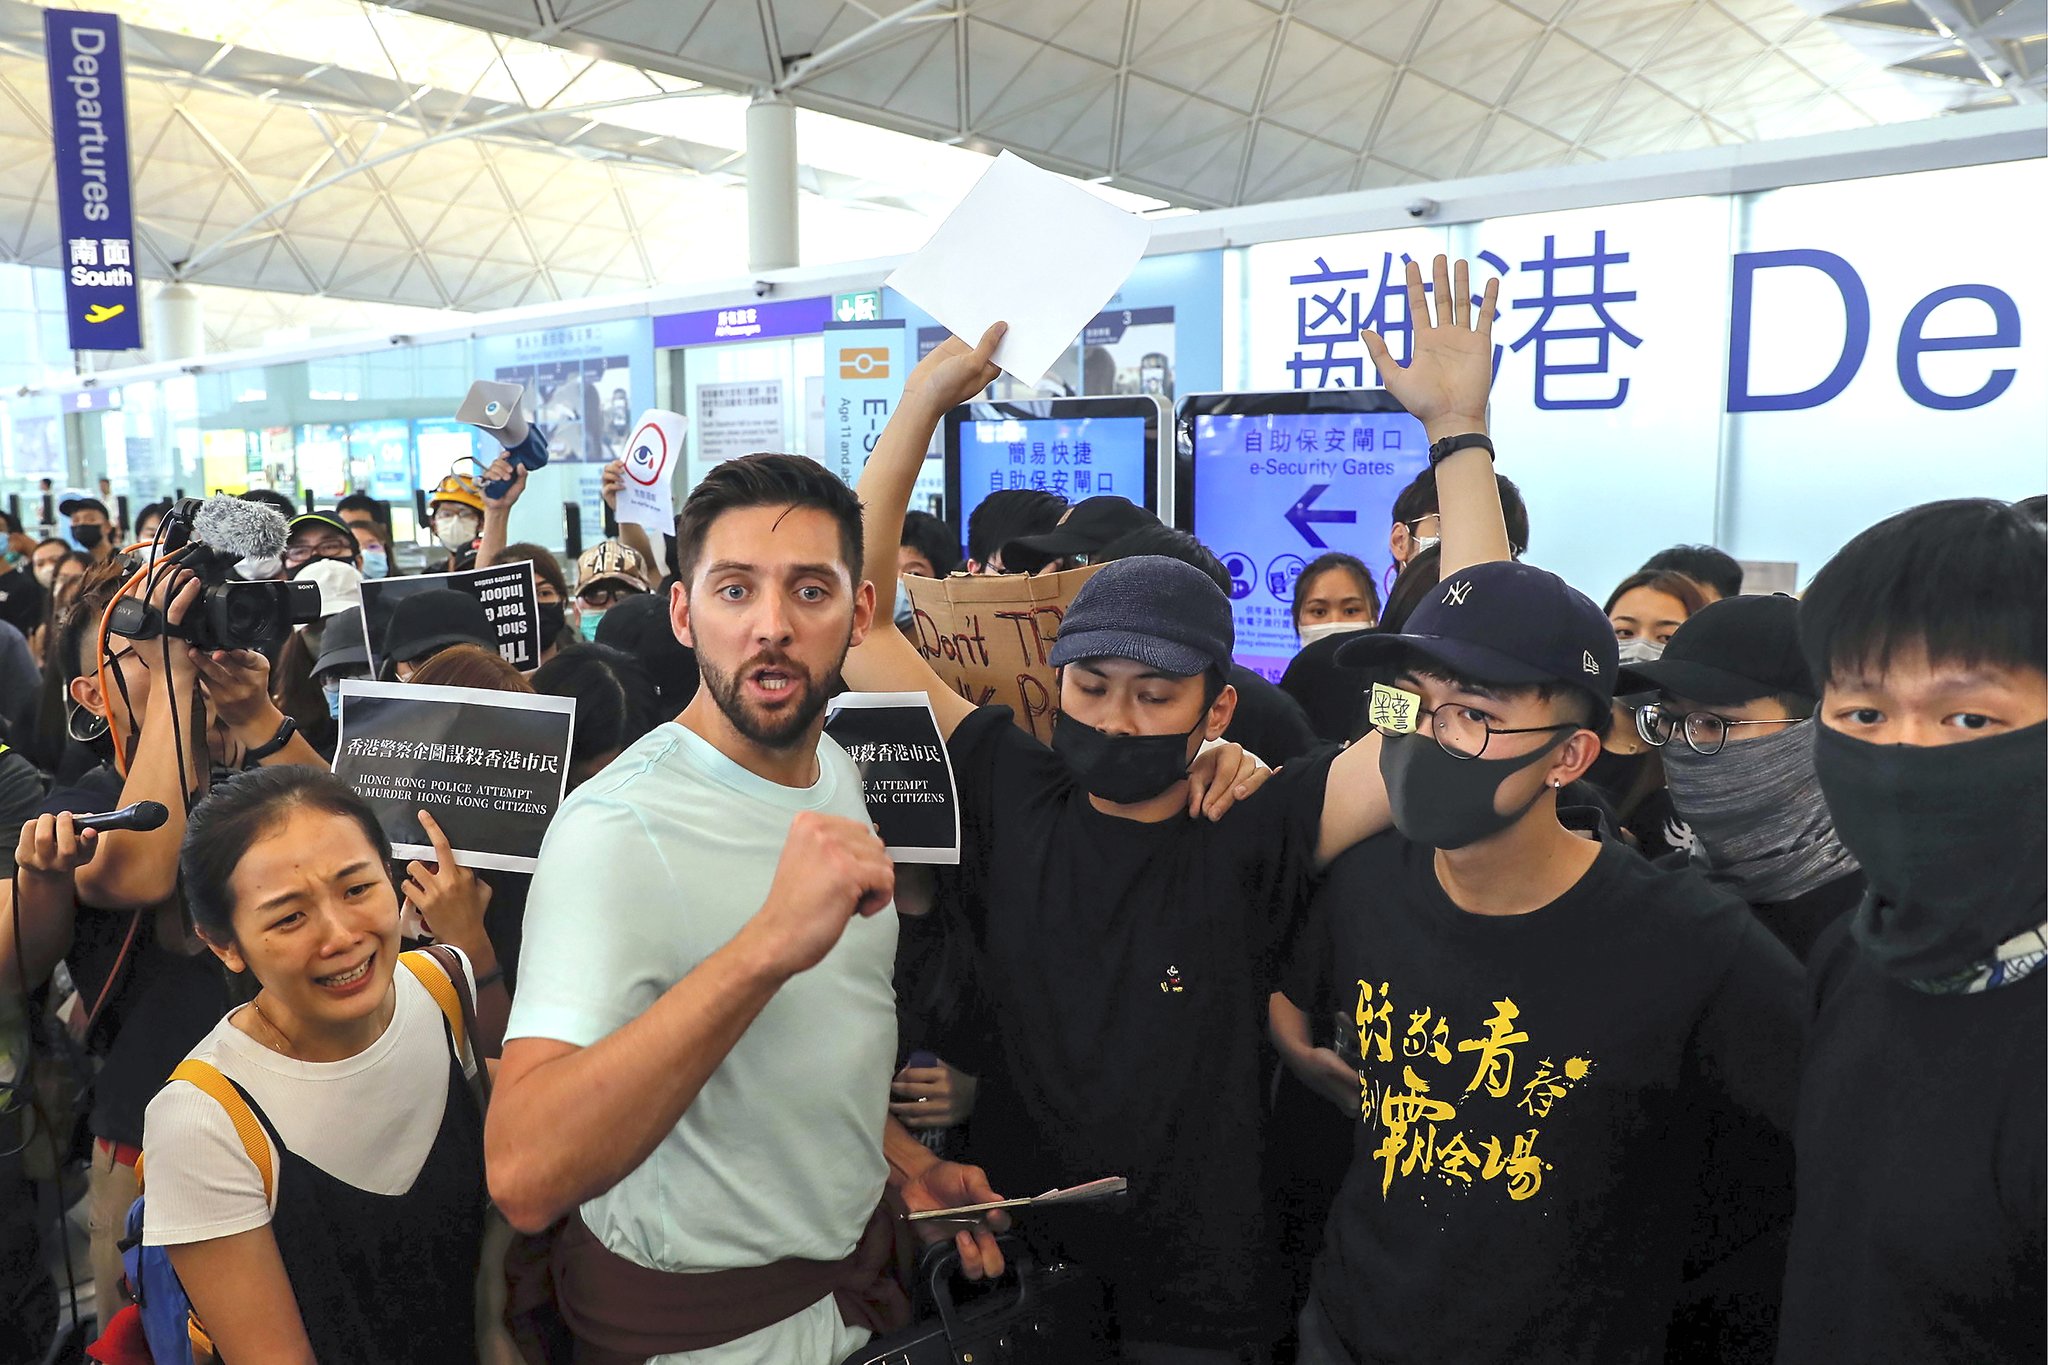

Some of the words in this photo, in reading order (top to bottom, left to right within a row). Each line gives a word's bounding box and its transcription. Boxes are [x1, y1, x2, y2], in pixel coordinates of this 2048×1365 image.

[66, 27, 111, 221] Departures
[69, 237, 131, 266] 南面
[71, 265, 133, 286] South
[1122, 310, 1132, 325] 3
[1727, 248, 2022, 413] De
[839, 398, 851, 422] Age
[841, 427, 851, 438] 11
[863, 399, 887, 467] E-S
[1245, 428, 1402, 453] 自助保安閘口
[841, 441, 851, 465] and
[1008, 441, 1092, 465] 簡易快捷
[1250, 458, 1337, 478] e-Security
[1343, 459, 1394, 475] Gates
[990, 469, 1112, 493] 自助保安閘口
[480, 584, 524, 602] Indoor
[485, 608, 495, 621] G
[497, 602, 526, 618] Tear
[497, 621, 527, 637] Shot
[909, 589, 989, 668] Don't
[994, 604, 1063, 667] TR
[499, 640, 529, 664] TH
[348, 738, 558, 774] 香港警察企圖謀殺香港市民
[359, 774, 390, 786] HONG
[394, 777, 426, 790] KONG
[430, 780, 472, 794] POLICE
[476, 785, 533, 800] ATTEMPT
[873, 780, 929, 791] ATTEMPT
[365, 787, 412, 800] MURDER
[417, 792, 451, 805] HONG
[456, 795, 489, 809] KONG
[494, 799, 547, 815] CITIZENS
[864, 793, 887, 804] ONG
[892, 793, 945, 804] CITIZENS
